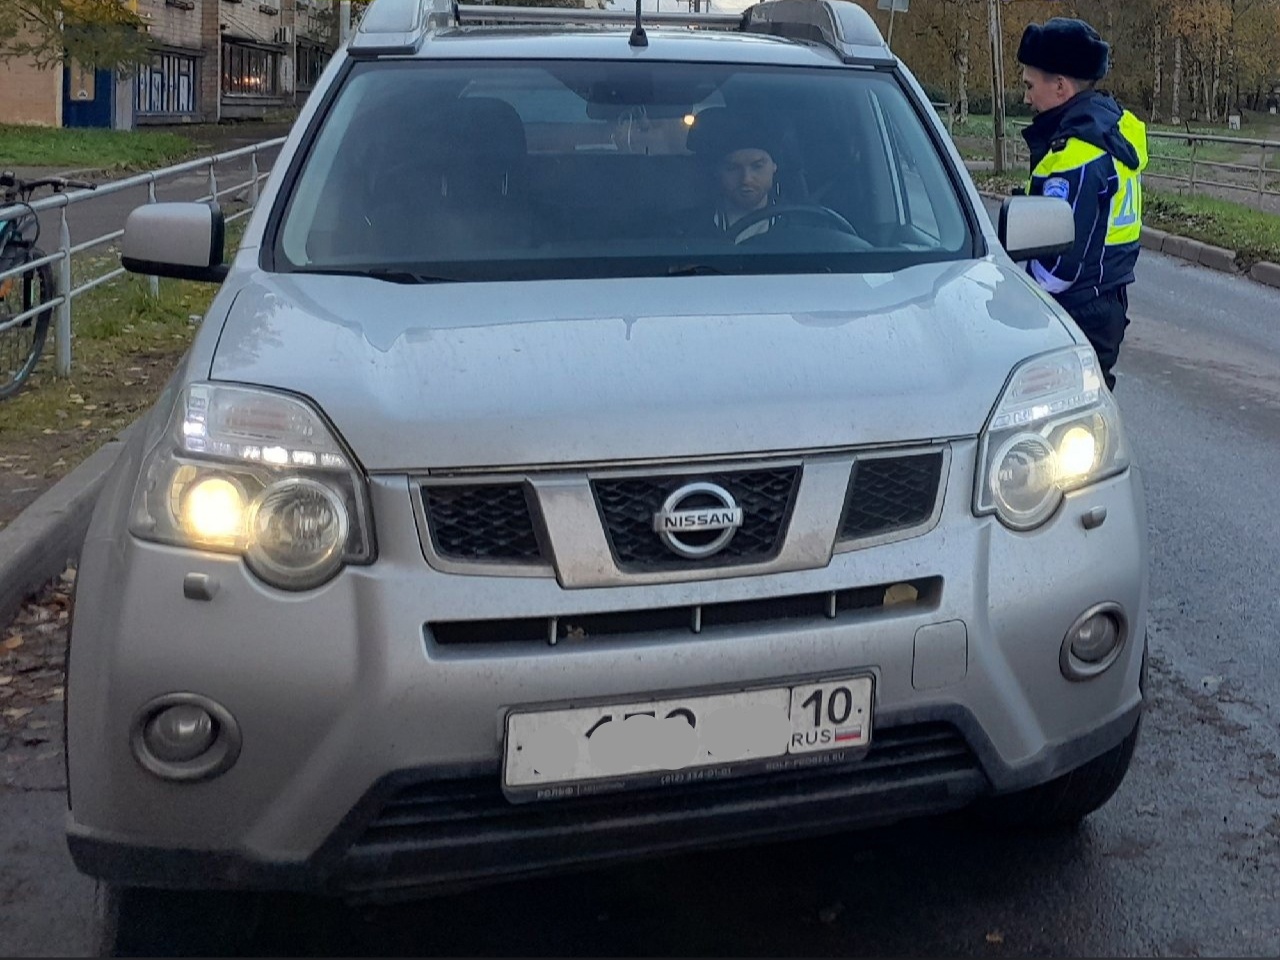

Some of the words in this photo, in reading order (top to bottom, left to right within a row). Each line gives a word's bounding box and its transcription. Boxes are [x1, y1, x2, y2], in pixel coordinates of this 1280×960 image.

[664, 512, 734, 528] NISSAN
[801, 686, 853, 727] 10
[791, 729, 832, 747] RUS
